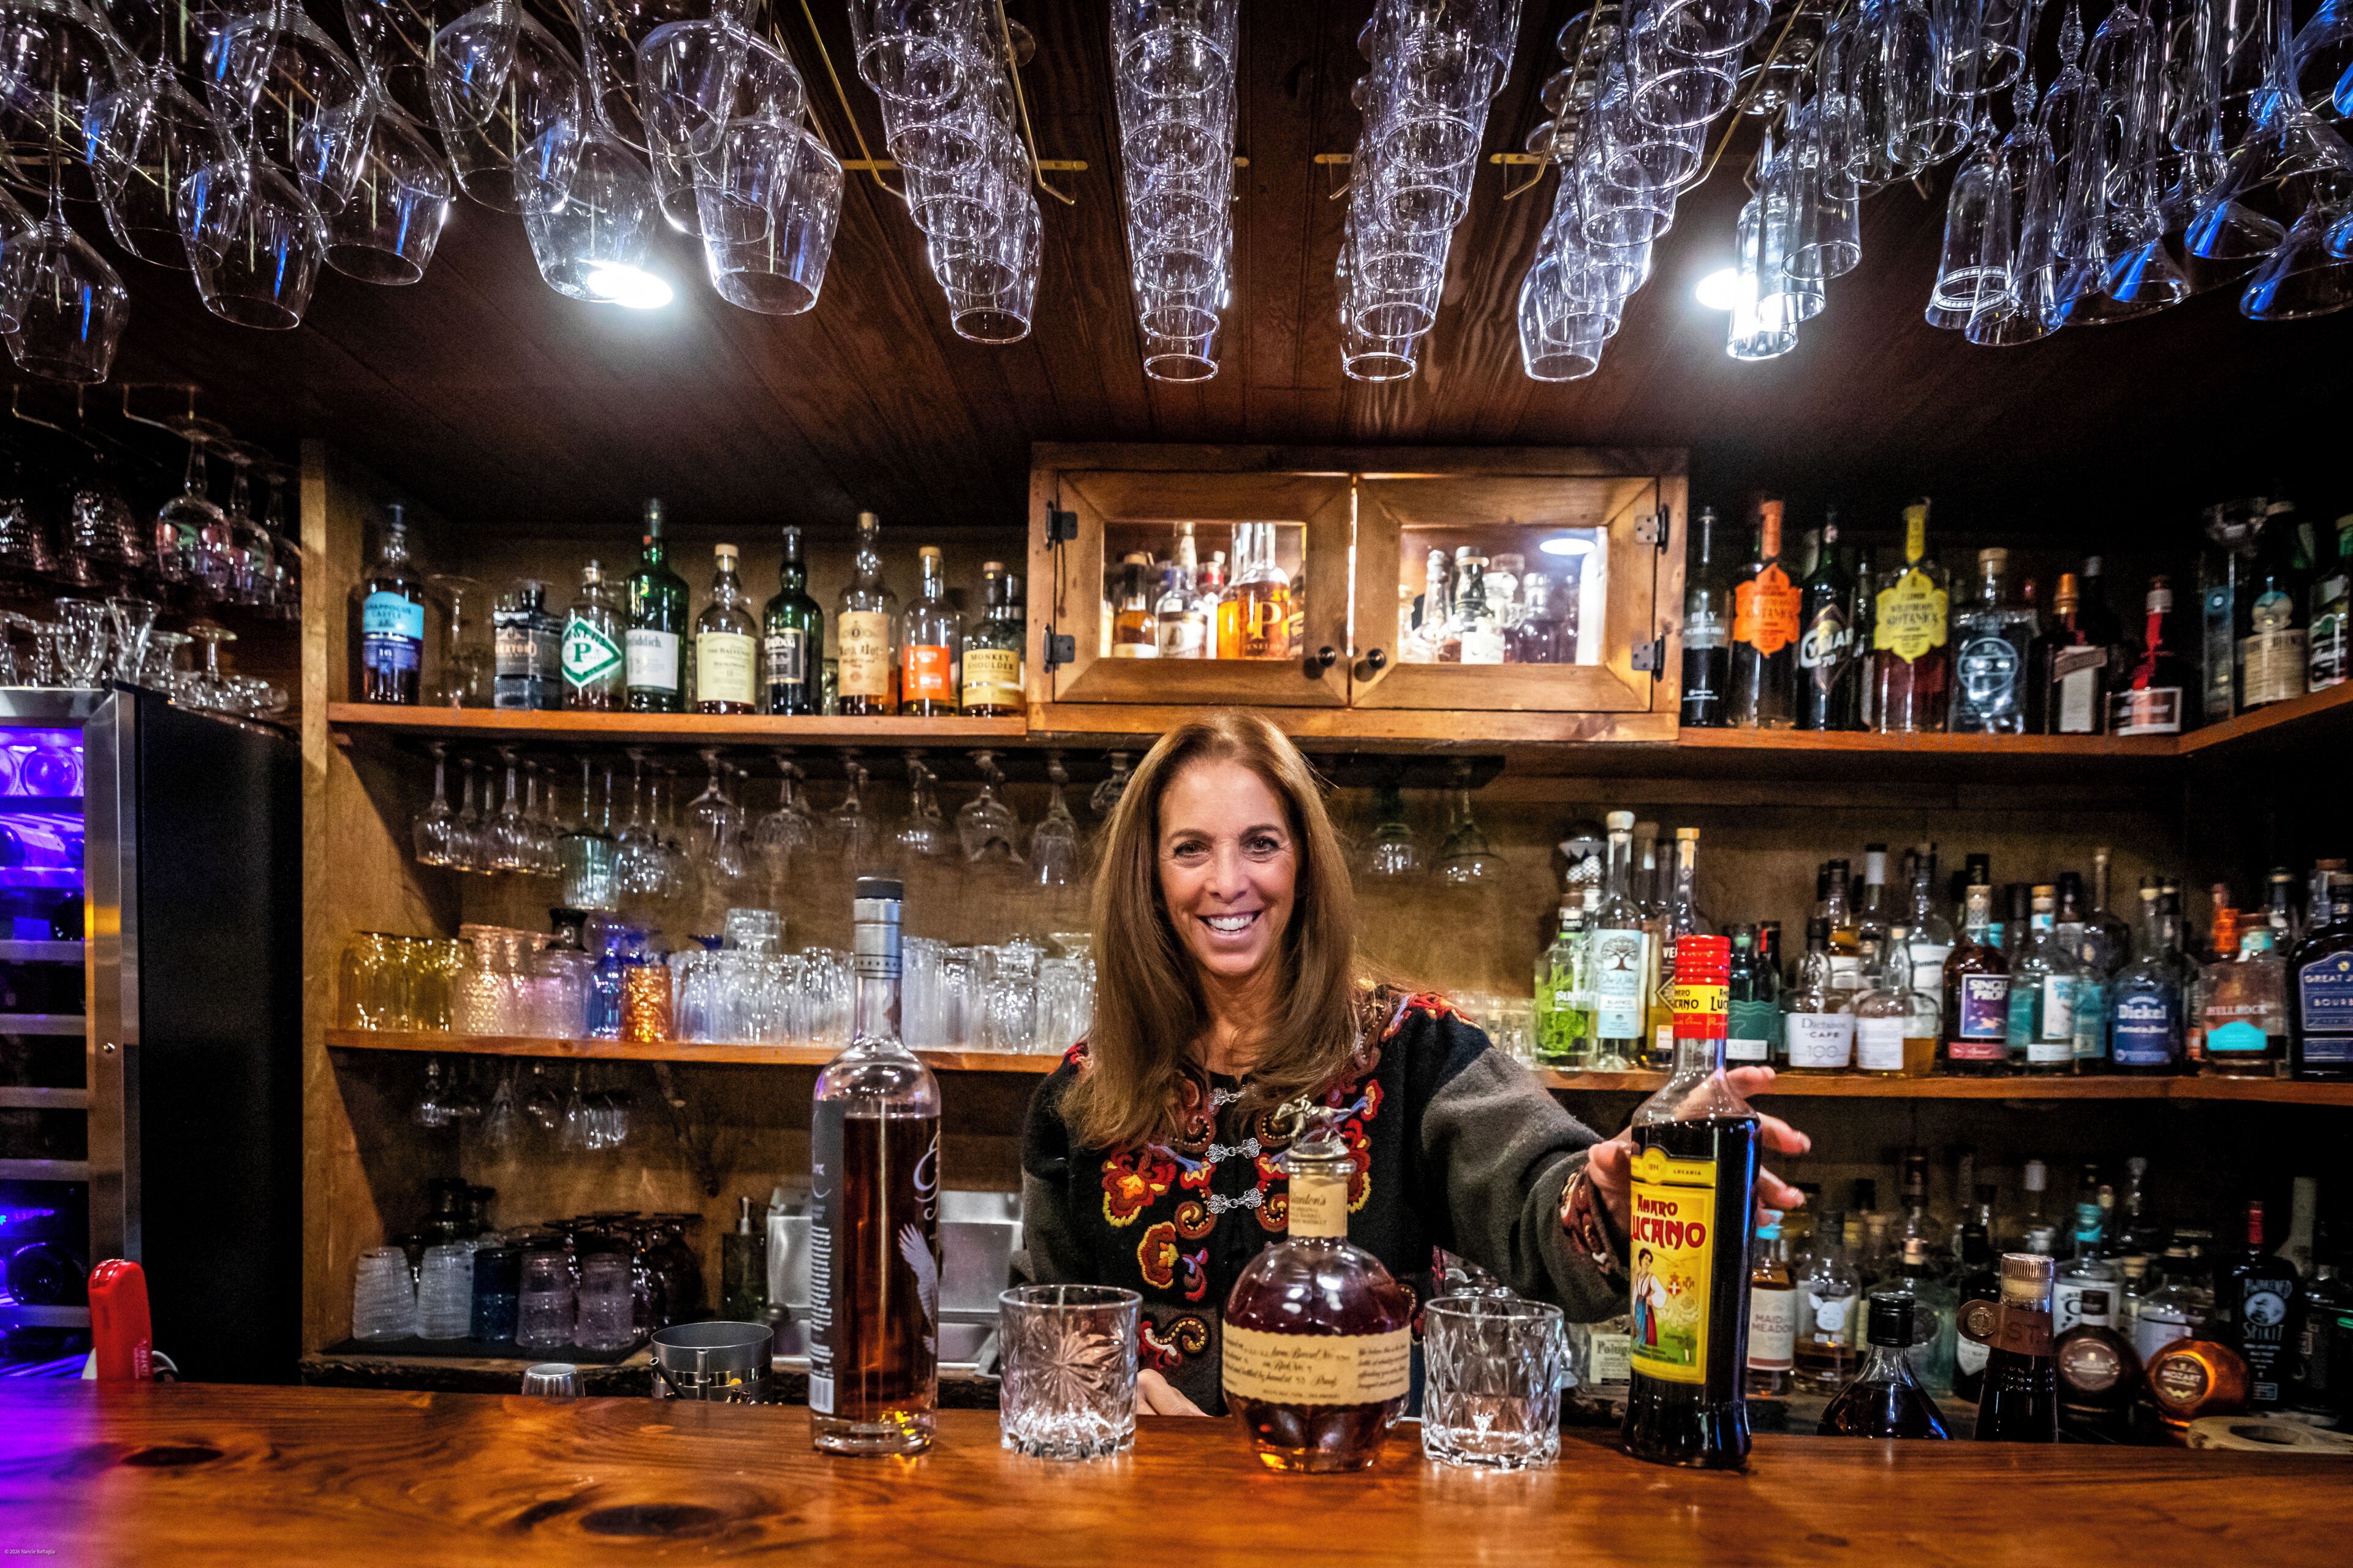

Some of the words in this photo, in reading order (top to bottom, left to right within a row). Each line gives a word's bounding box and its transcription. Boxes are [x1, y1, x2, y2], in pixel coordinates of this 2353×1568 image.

[1251, 601, 1282, 639] P
[574, 643, 592, 662] P
[971, 654, 1010, 662] MONKEY
[1673, 999, 1699, 1010] CANO
[2118, 1004, 2167, 1020] Dickel
[1290, 1192, 1327, 1206] lanton's
[1631, 1214, 1707, 1251] UCANO
